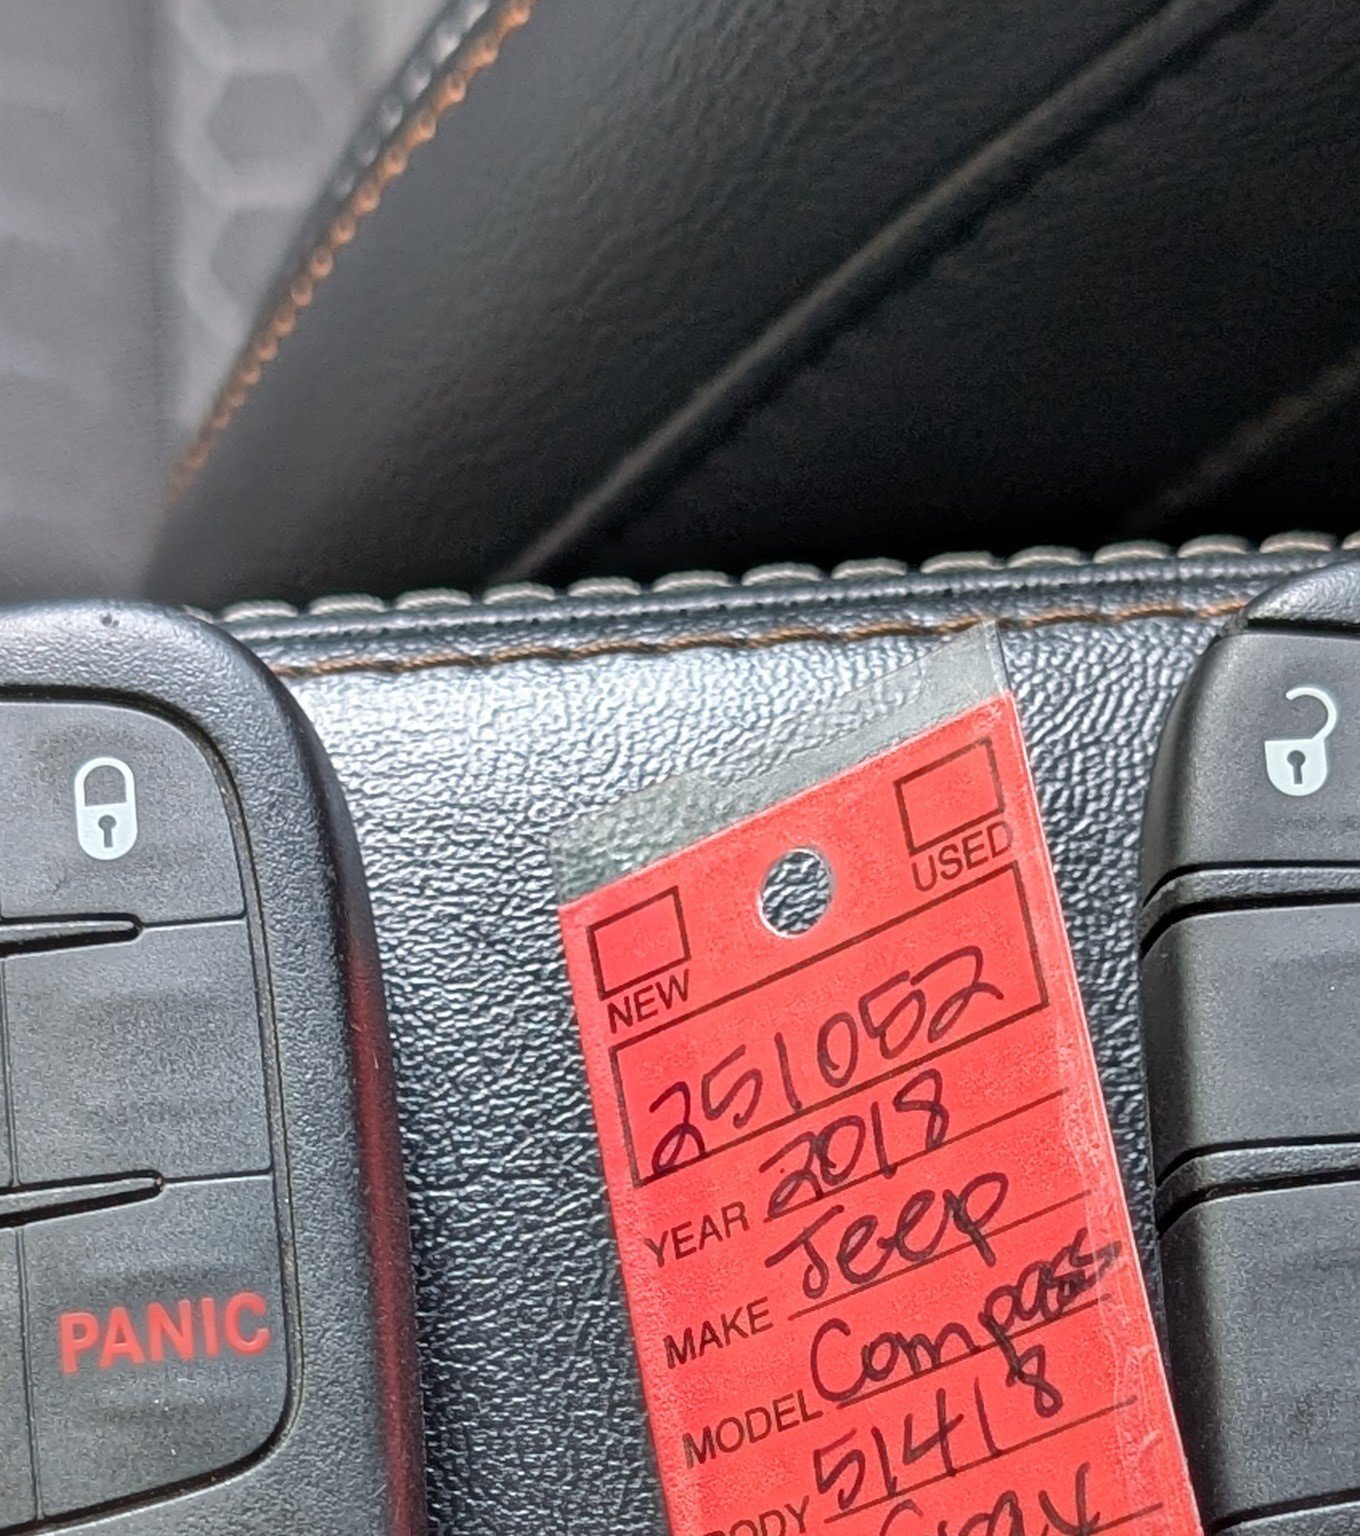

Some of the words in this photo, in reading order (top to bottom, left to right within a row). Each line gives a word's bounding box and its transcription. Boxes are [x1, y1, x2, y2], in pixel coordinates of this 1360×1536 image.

[607, 970, 691, 1035] NEW
[910, 820, 1014, 893] USED
[649, 946, 1005, 1177] 251052
[759, 1068, 949, 1221] 2018
[643, 1202, 749, 1268] YEAR
[765, 1173, 1008, 1299] Jeep
[58, 1290, 273, 1376] PANIC
[664, 1297, 775, 1369] MAKE
[683, 1389, 823, 1469] MODEL
[814, 1346, 1064, 1512] 51418
